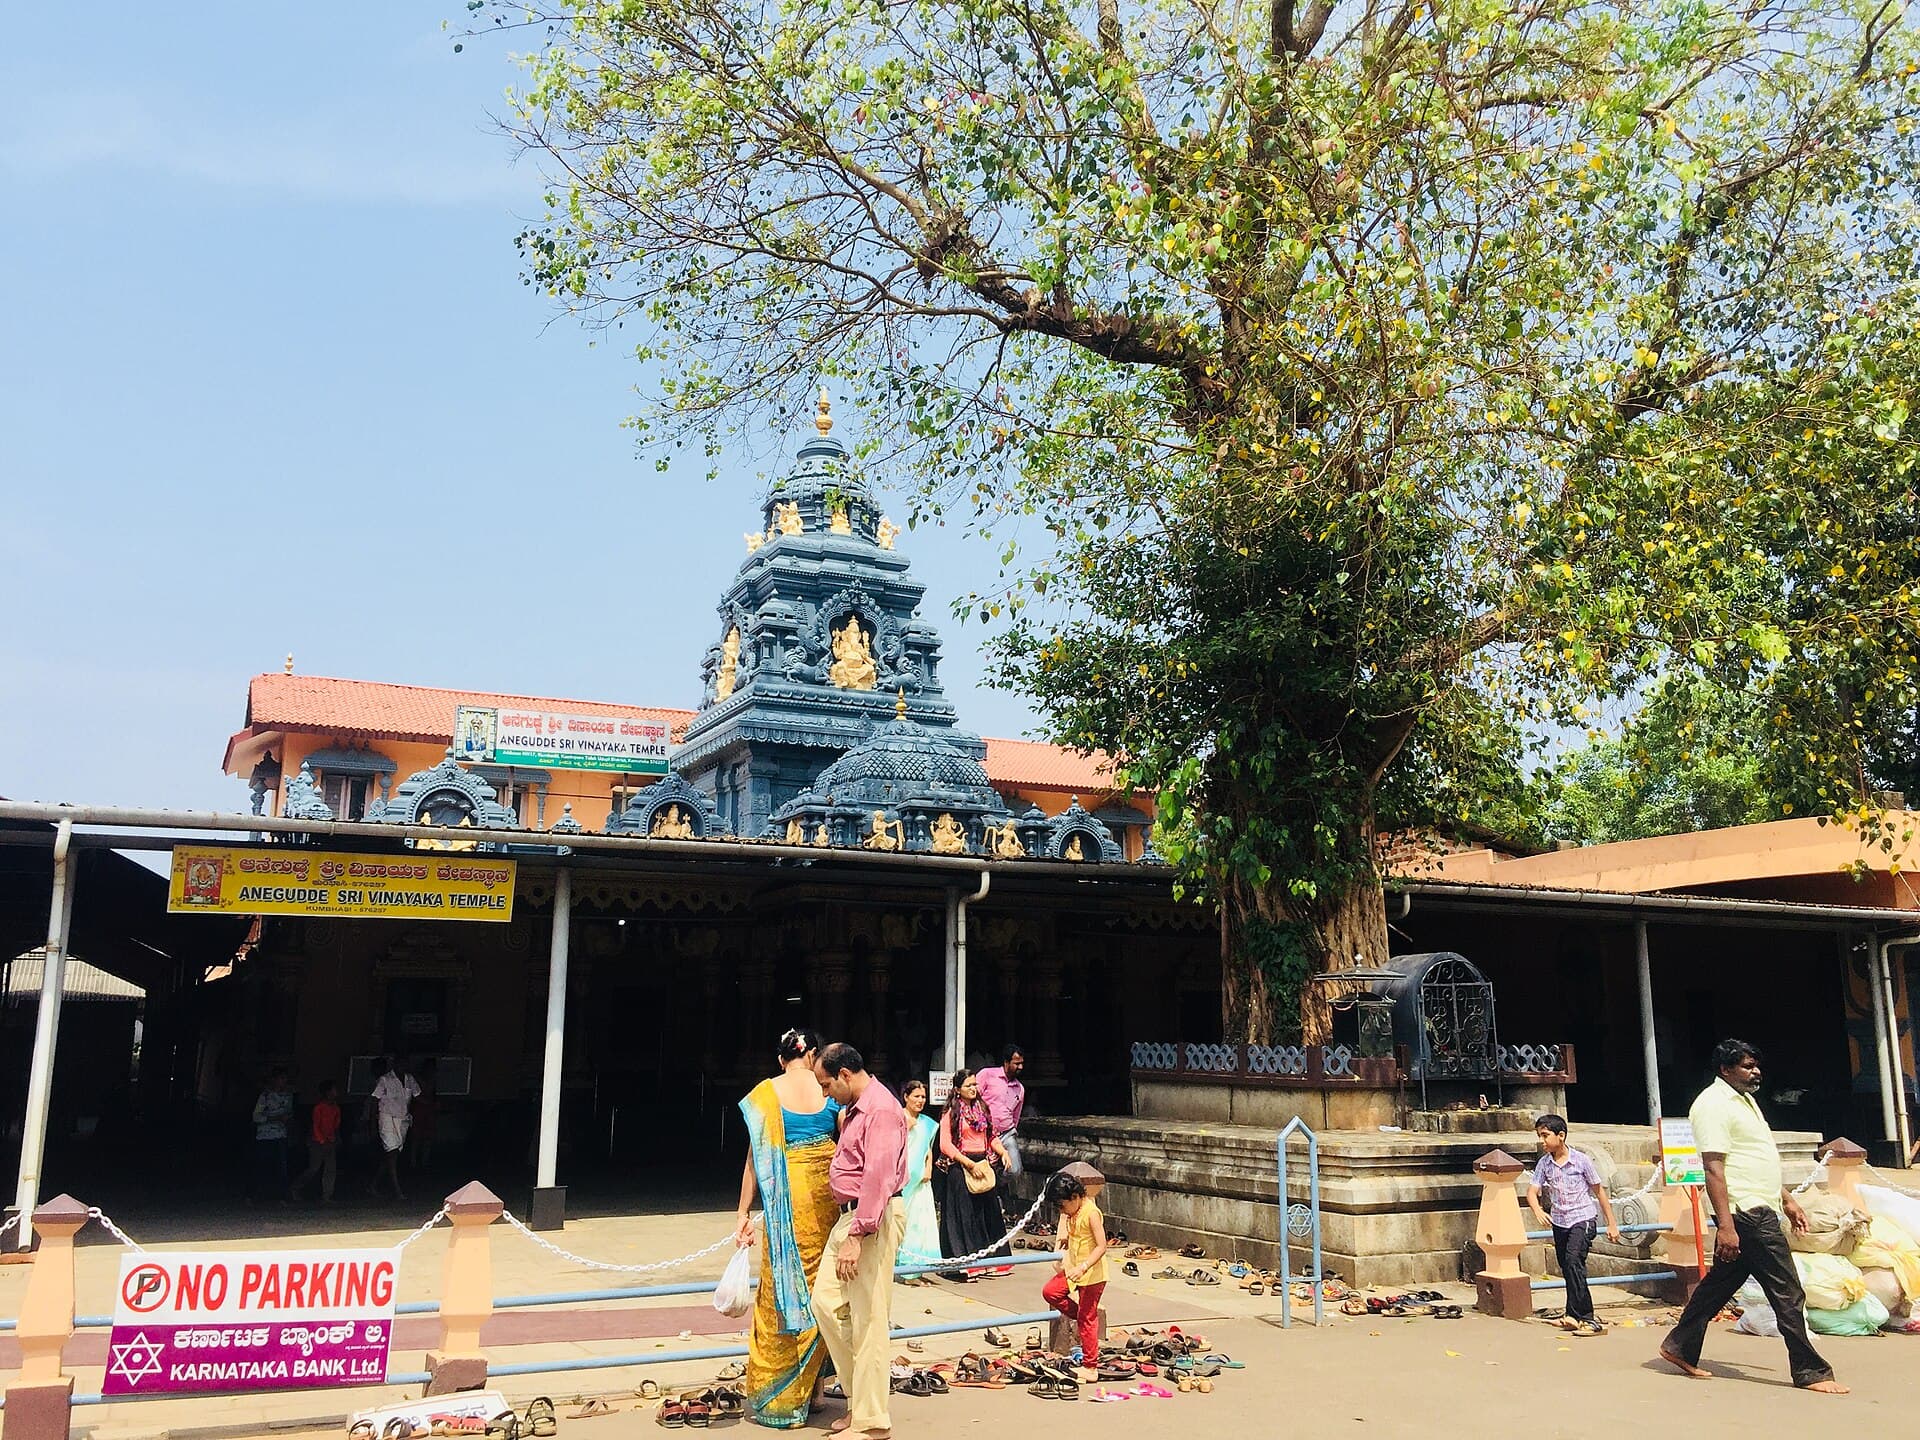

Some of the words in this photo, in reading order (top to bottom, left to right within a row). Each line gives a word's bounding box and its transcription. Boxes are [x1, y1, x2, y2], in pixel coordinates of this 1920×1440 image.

[568, 719, 615, 734] ವಿನಾಯಕ
[500, 735, 556, 748] ANEGUDDE
[559, 738, 574, 749] SRI
[578, 740, 627, 752] VINAYAKA
[630, 743, 666, 755] TEMPLE
[320, 860, 345, 880] ಶ್ರೀ
[348, 862, 428, 880] ವಿನಾಯಕ
[436, 864, 509, 889] ದೇವಸ್ಥಾನ
[239, 886, 329, 904] ANEGUDDE
[337, 890, 364, 905] SRI
[367, 890, 443, 907] VINAYAKA
[447, 893, 507, 910] TEMPLE
[305, 905, 352, 913] KUMBHASI
[174, 1263, 228, 1311] NO
[238, 1261, 394, 1311] PARKING
[173, 1326, 270, 1349] ಕರ್ಣಾಟಕ
[279, 1321, 355, 1356] ಬ್ಯಾಂಕ್
[364, 1323, 387, 1344] ಲಿ.
[169, 1360, 291, 1381] KARNATAKA
[293, 1360, 347, 1378] BANK
[350, 1357, 383, 1375] Ltd.
